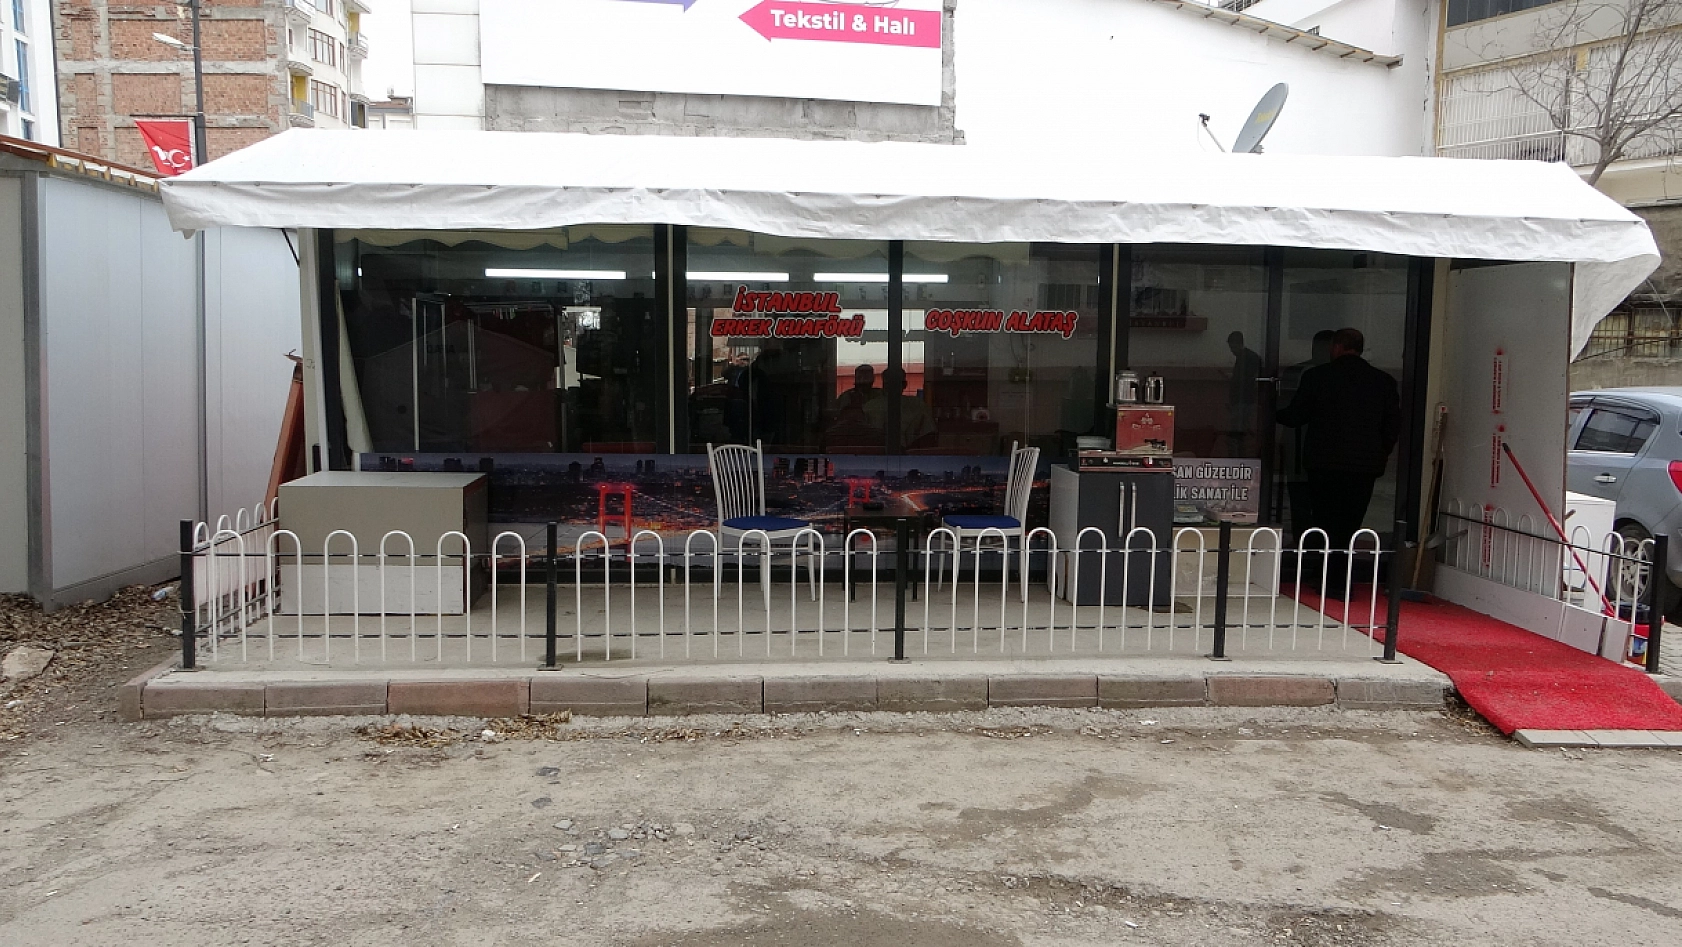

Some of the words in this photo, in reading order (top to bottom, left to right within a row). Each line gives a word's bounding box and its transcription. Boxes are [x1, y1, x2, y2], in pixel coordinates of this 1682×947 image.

[770, 9, 845, 31] Tekstil
[851, 14, 867, 32] &
[873, 17, 915, 35] Halı
[733, 285, 843, 313] İSTANBUL
[711, 318, 773, 338] ERKEK
[773, 314, 866, 338] KUAFÖRÜ
[925, 308, 1004, 337] COŞKUN
[1004, 309, 1079, 339] ALATAŞ
[1195, 463, 1252, 480] GÜZELDİR
[1191, 487, 1228, 500] SANAT
[1230, 484, 1249, 500] İLE
